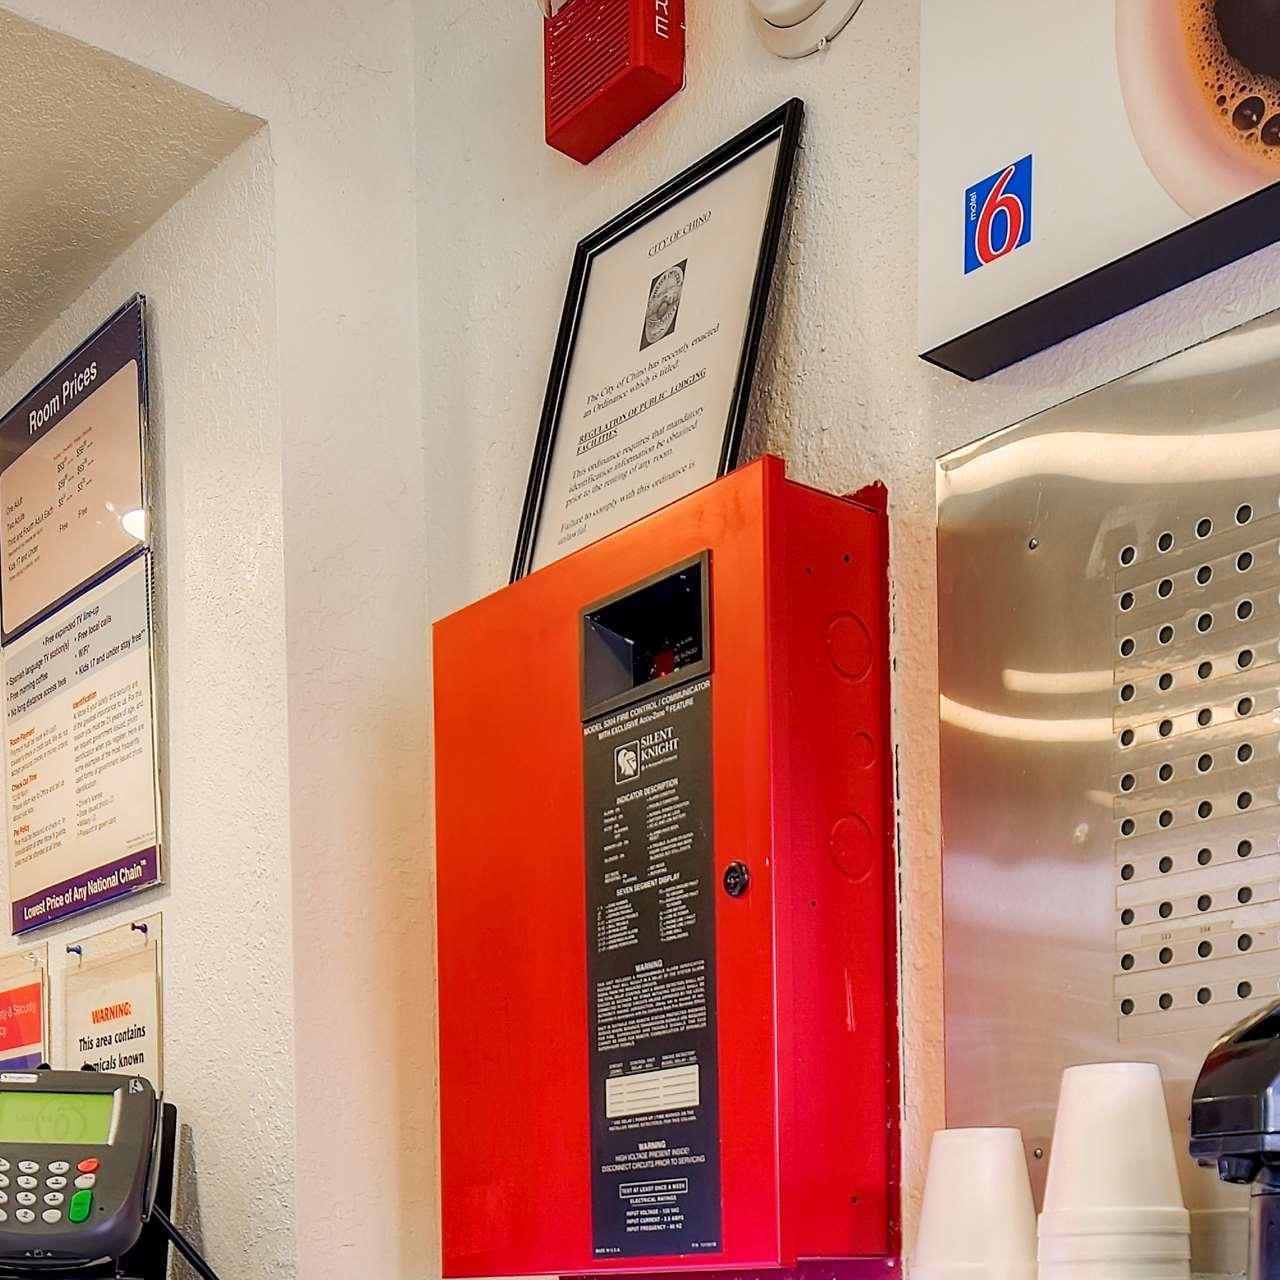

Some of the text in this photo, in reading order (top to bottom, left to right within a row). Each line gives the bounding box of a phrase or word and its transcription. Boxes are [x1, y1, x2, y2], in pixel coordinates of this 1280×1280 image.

[969, 191, 977, 221] motel
[975, 165, 1024, 265] 6
[648, 210, 712, 257] CITY OF CHINO
[586, 322, 720, 405] The City of Chino has recently enacted
[29, 360, 98, 435] Room Prices
[578, 367, 707, 445] REGULATION OF PUBLIC LODGING
[583, 409, 592, 418] an
[593, 392, 627, 413] Ordinance
[629, 376, 650, 393] which
[568, 419, 698, 494] identification information be obtained
[572, 407, 704, 480] This ordinance requires that mandatory
[575, 429, 617, 457] FACILITIES
[77, 615, 112, 641] Free local calls
[78, 639, 131, 675] Kids 17 and under stay
[583, 723, 603, 736] MODEL
[616, 711, 629, 723] FIRE
[630, 701, 658, 721] CONTROL
[661, 680, 711, 706] COMMUNICATOR
[598, 697, 694, 740] WITH EXCLUSIVE FEATURE
[640, 726, 673, 748] SILENT
[641, 738, 680, 761] KNIGHT
[616, 777, 679, 804] INDICATOR DESCRIPTION
[23, 900, 45, 920] Lowest
[46, 894, 64, 912] Price
[64, 888, 73, 904] of
[73, 885, 87, 902] Any
[88, 871, 119, 896] National
[616, 872, 680, 897] SEVEN SEGMENT DISPLAY
[634, 959, 663, 972] WARNING
[92, 1002, 132, 1025] WARNING:
[79, 1024, 146, 1052] This area contains
[118, 1052, 145, 1068] known
[627, 1151, 648, 1160] VOLTAGE
[648, 1149, 671, 1159] PRESENT
[638, 1140, 666, 1151] WARNING
[601, 1164, 632, 1173] DISCONNECT
[632, 1161, 654, 1170] CIRCUITS
[655, 1159, 670, 1168] PRIOR
[671, 1158, 678, 1166] TO
[639, 1185, 654, 1193] LEAST
